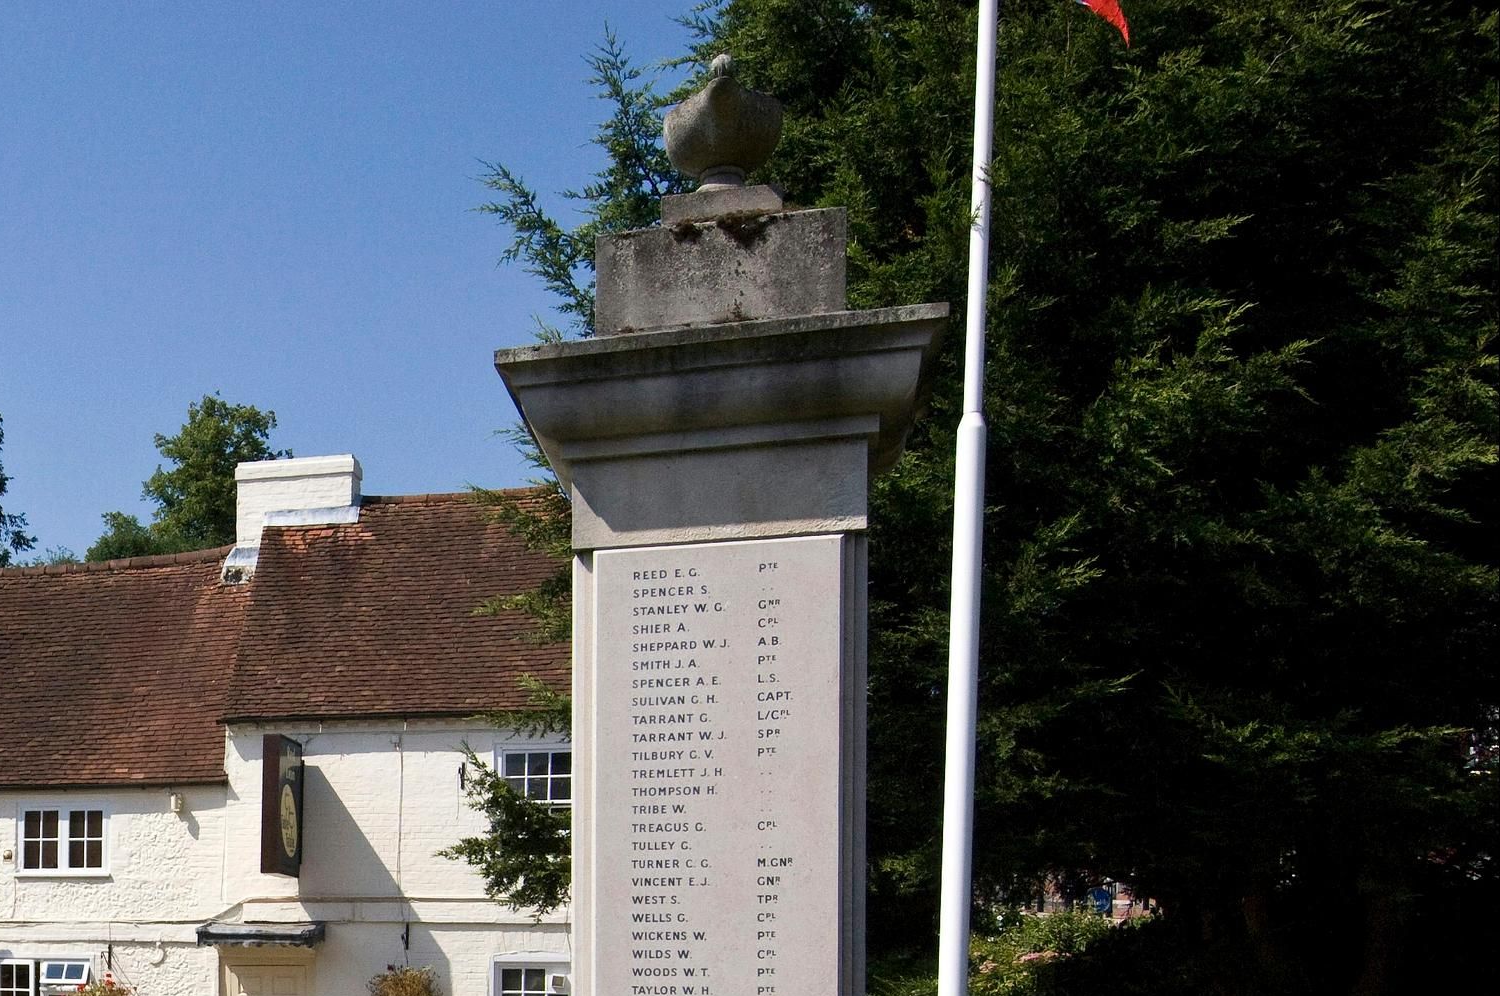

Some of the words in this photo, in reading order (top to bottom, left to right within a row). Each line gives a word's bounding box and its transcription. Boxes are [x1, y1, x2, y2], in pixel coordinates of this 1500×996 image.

[633, 570, 668, 580] REED
[633, 586, 694, 598] SPENCER
[701, 585, 711, 594] S.
[633, 605, 689, 616] STANLEY
[632, 624, 671, 634] SHIER
[677, 623, 690, 632] A.
[632, 641, 697, 652] SHEPPARD
[632, 660, 670, 670] SMITH
[632, 678, 690, 688] SPENCER
[632, 696, 685, 706] SULIVAN
[632, 714, 694, 724] TARRANT
[699, 713, 712, 722] G.
[632, 732, 693, 742] TARRANT
[632, 751, 684, 760] TILBURY
[632, 769, 696, 778] TREMLETT
[632, 786, 701, 796] THOMPSON
[707, 786, 718, 794] H.
[632, 805, 667, 814] TRIBE
[672, 805, 686, 813] W.
[632, 823, 689, 832] TREAGUS
[695, 823, 706, 831] G.
[632, 842, 675, 850] TULLEY
[681, 841, 692, 850] G.
[632, 860, 680, 868] TURNER
[632, 878, 683, 886] VINCENT
[632, 896, 666, 904] WEST
[670, 896, 681, 904] S.
[632, 914, 672, 922] WELLS
[677, 914, 689, 922] G.
[632, 932, 687, 940] WICKENS
[693, 932, 707, 940] W.
[632, 950, 671, 958] WILDS
[677, 950, 692, 958] W.
[632, 968, 677, 976] WOODS
[631, 986, 677, 995] TAYLOR
